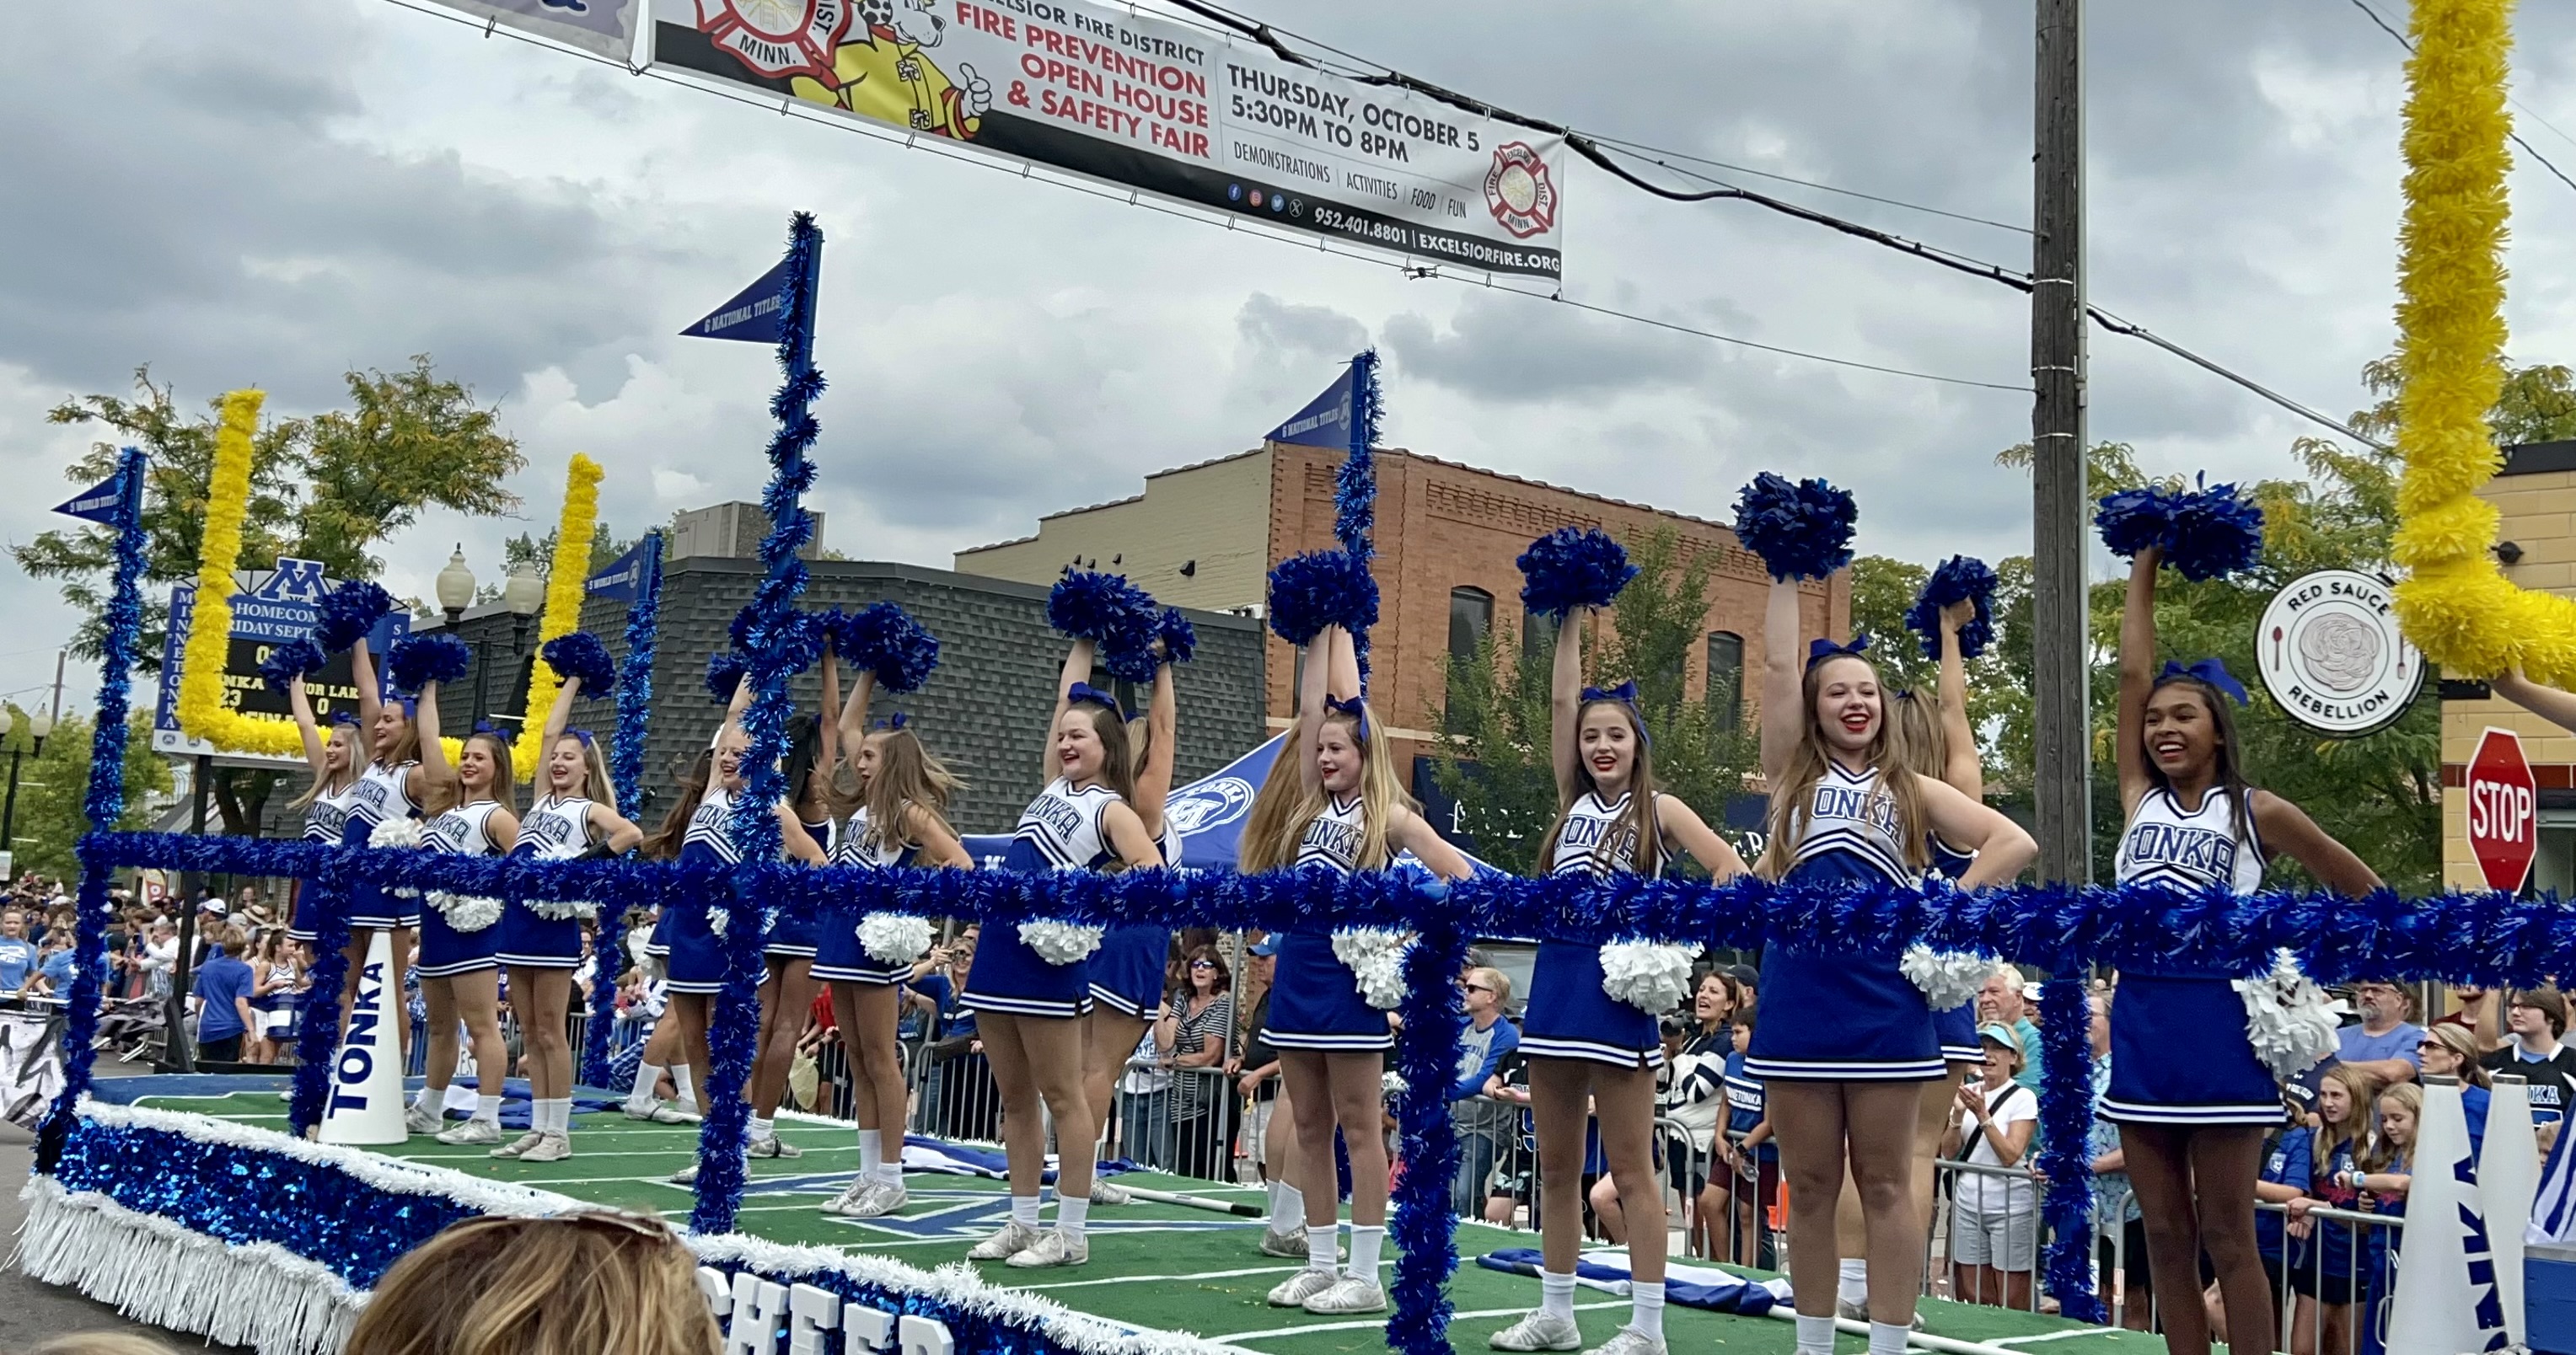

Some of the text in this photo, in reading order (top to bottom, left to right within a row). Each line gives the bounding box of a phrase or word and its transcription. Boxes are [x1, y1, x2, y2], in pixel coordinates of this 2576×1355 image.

[812, 0, 835, 35] IST.
[988, 0, 1204, 67] LSIOR FIRE DISTRICT
[738, 33, 797, 65] MINN.
[956, 1, 1206, 99] FIRE PREVENTION
[1021, 53, 1208, 128] OPEN HOUSE
[1227, 63, 1480, 152] THURSDAY, OCTOBER 5
[1007, 80, 1210, 158] & SAFETY FAIR
[1232, 94, 1409, 163] 5:30PM TO 8PM
[1234, 141, 1467, 218] DEMONSTRATIONS ACTIVITIES FOOD FUN
[1489, 171, 1498, 195] FIRE
[1315, 207, 1559, 271] 952.401.8801 EXCELSIORFIRE.ORG
[1508, 213, 1532, 228] MINN.
[705, 295, 781, 333] 6 NATIONAL TITLES
[1288, 415, 1318, 436] NATIONAL
[1319, 408, 1339, 426] TITLES
[236, 603, 318, 623] HOMECOM
[2288, 582, 2390, 616] RED SAUCE
[230, 619, 274, 635] IDAY
[329, 685, 359, 699] LAK
[2289, 685, 2390, 719] REBELLION
[523, 811, 573, 844] ONKA
[1025, 795, 1081, 843] ONKA
[2472, 779, 2531, 843] STOP
[327, 962, 384, 1119] TONKA
